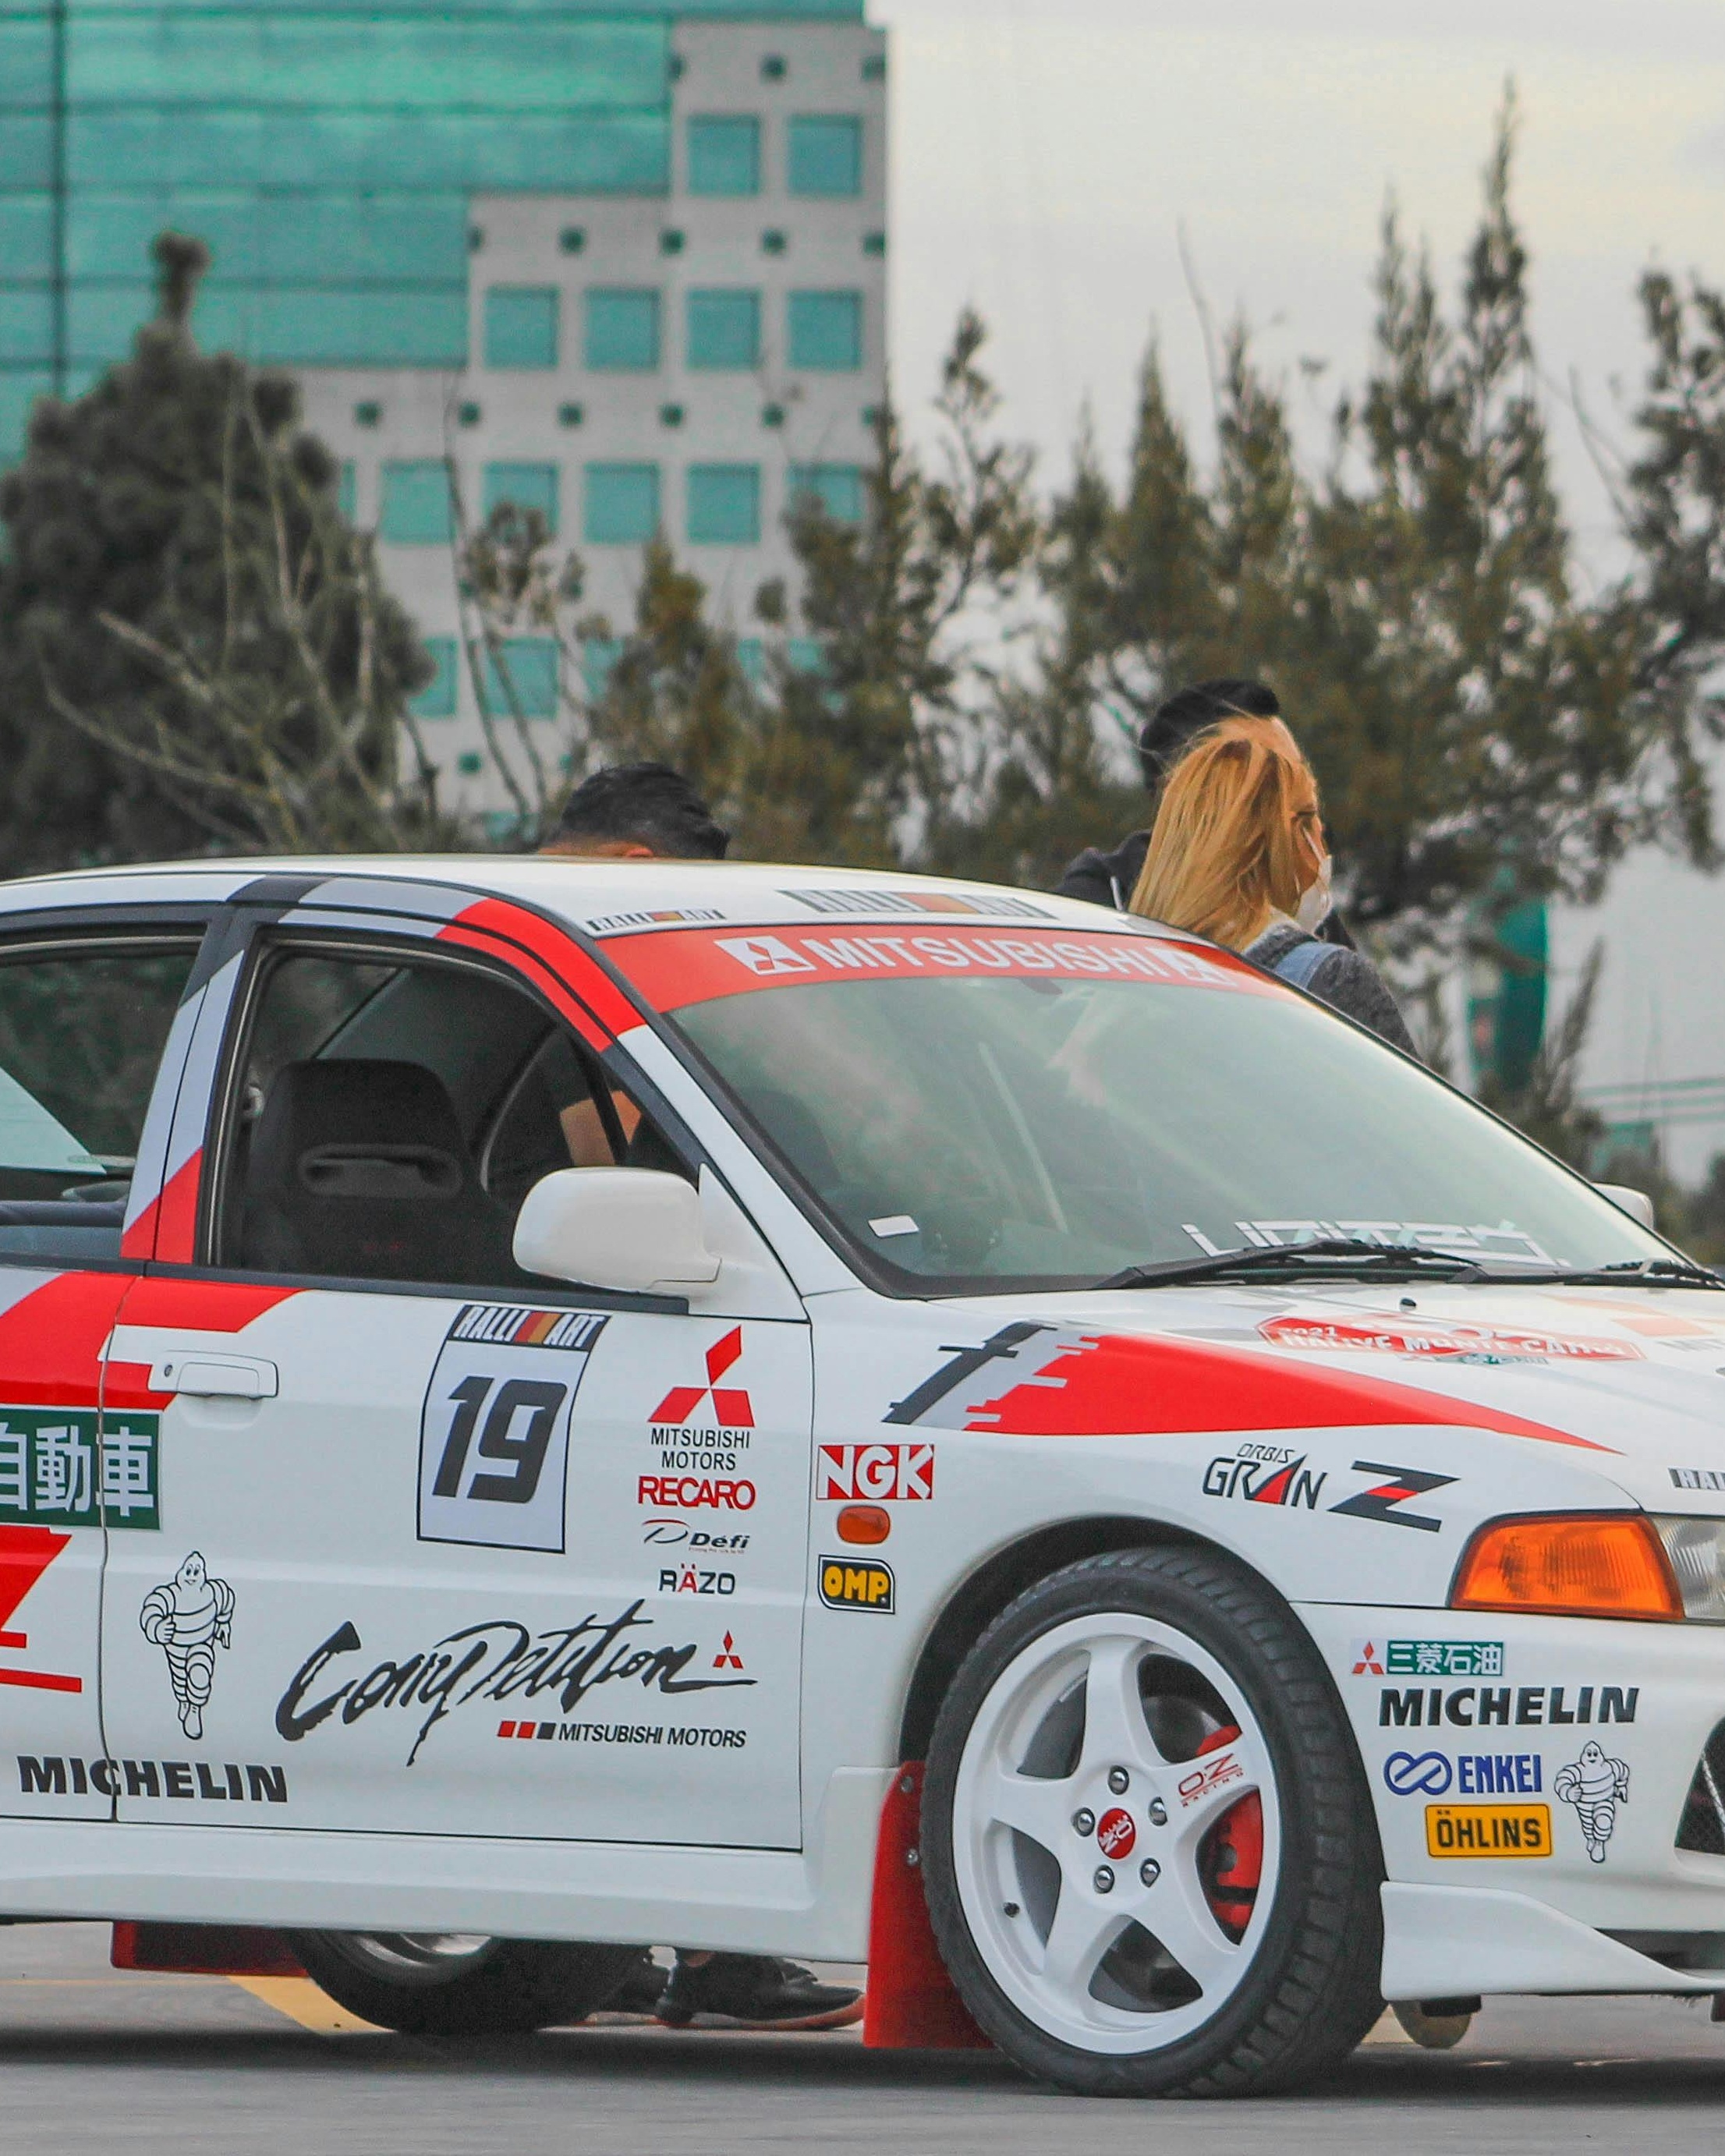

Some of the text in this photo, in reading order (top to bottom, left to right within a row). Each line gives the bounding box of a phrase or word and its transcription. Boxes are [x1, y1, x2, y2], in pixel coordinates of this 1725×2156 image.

[800, 936, 1163, 976] MITSUBISHI
[432, 1375, 568, 1504] 19
[651, 1428, 750, 1449] MITSUBISHI
[1237, 1443, 1295, 1464] ORBIS
[0, 1421, 154, 1517] 自動車
[661, 1451, 736, 1471] MOTORS
[817, 1444, 934, 1500] NGK
[638, 1476, 756, 1510] RECARO
[659, 1563, 735, 1595] RÄZO
[823, 1566, 890, 1603] OMP
[1388, 1641, 1502, 1675] 三菱石油
[1379, 1687, 1638, 1726] MICHELIN
[558, 1724, 747, 1747] MITSUBISHI MOTORS
[17, 1755, 288, 1803] MICHELIN
[1458, 1754, 1543, 1793] ENKEI
[1437, 1809, 1542, 1848] ÖHLINS
